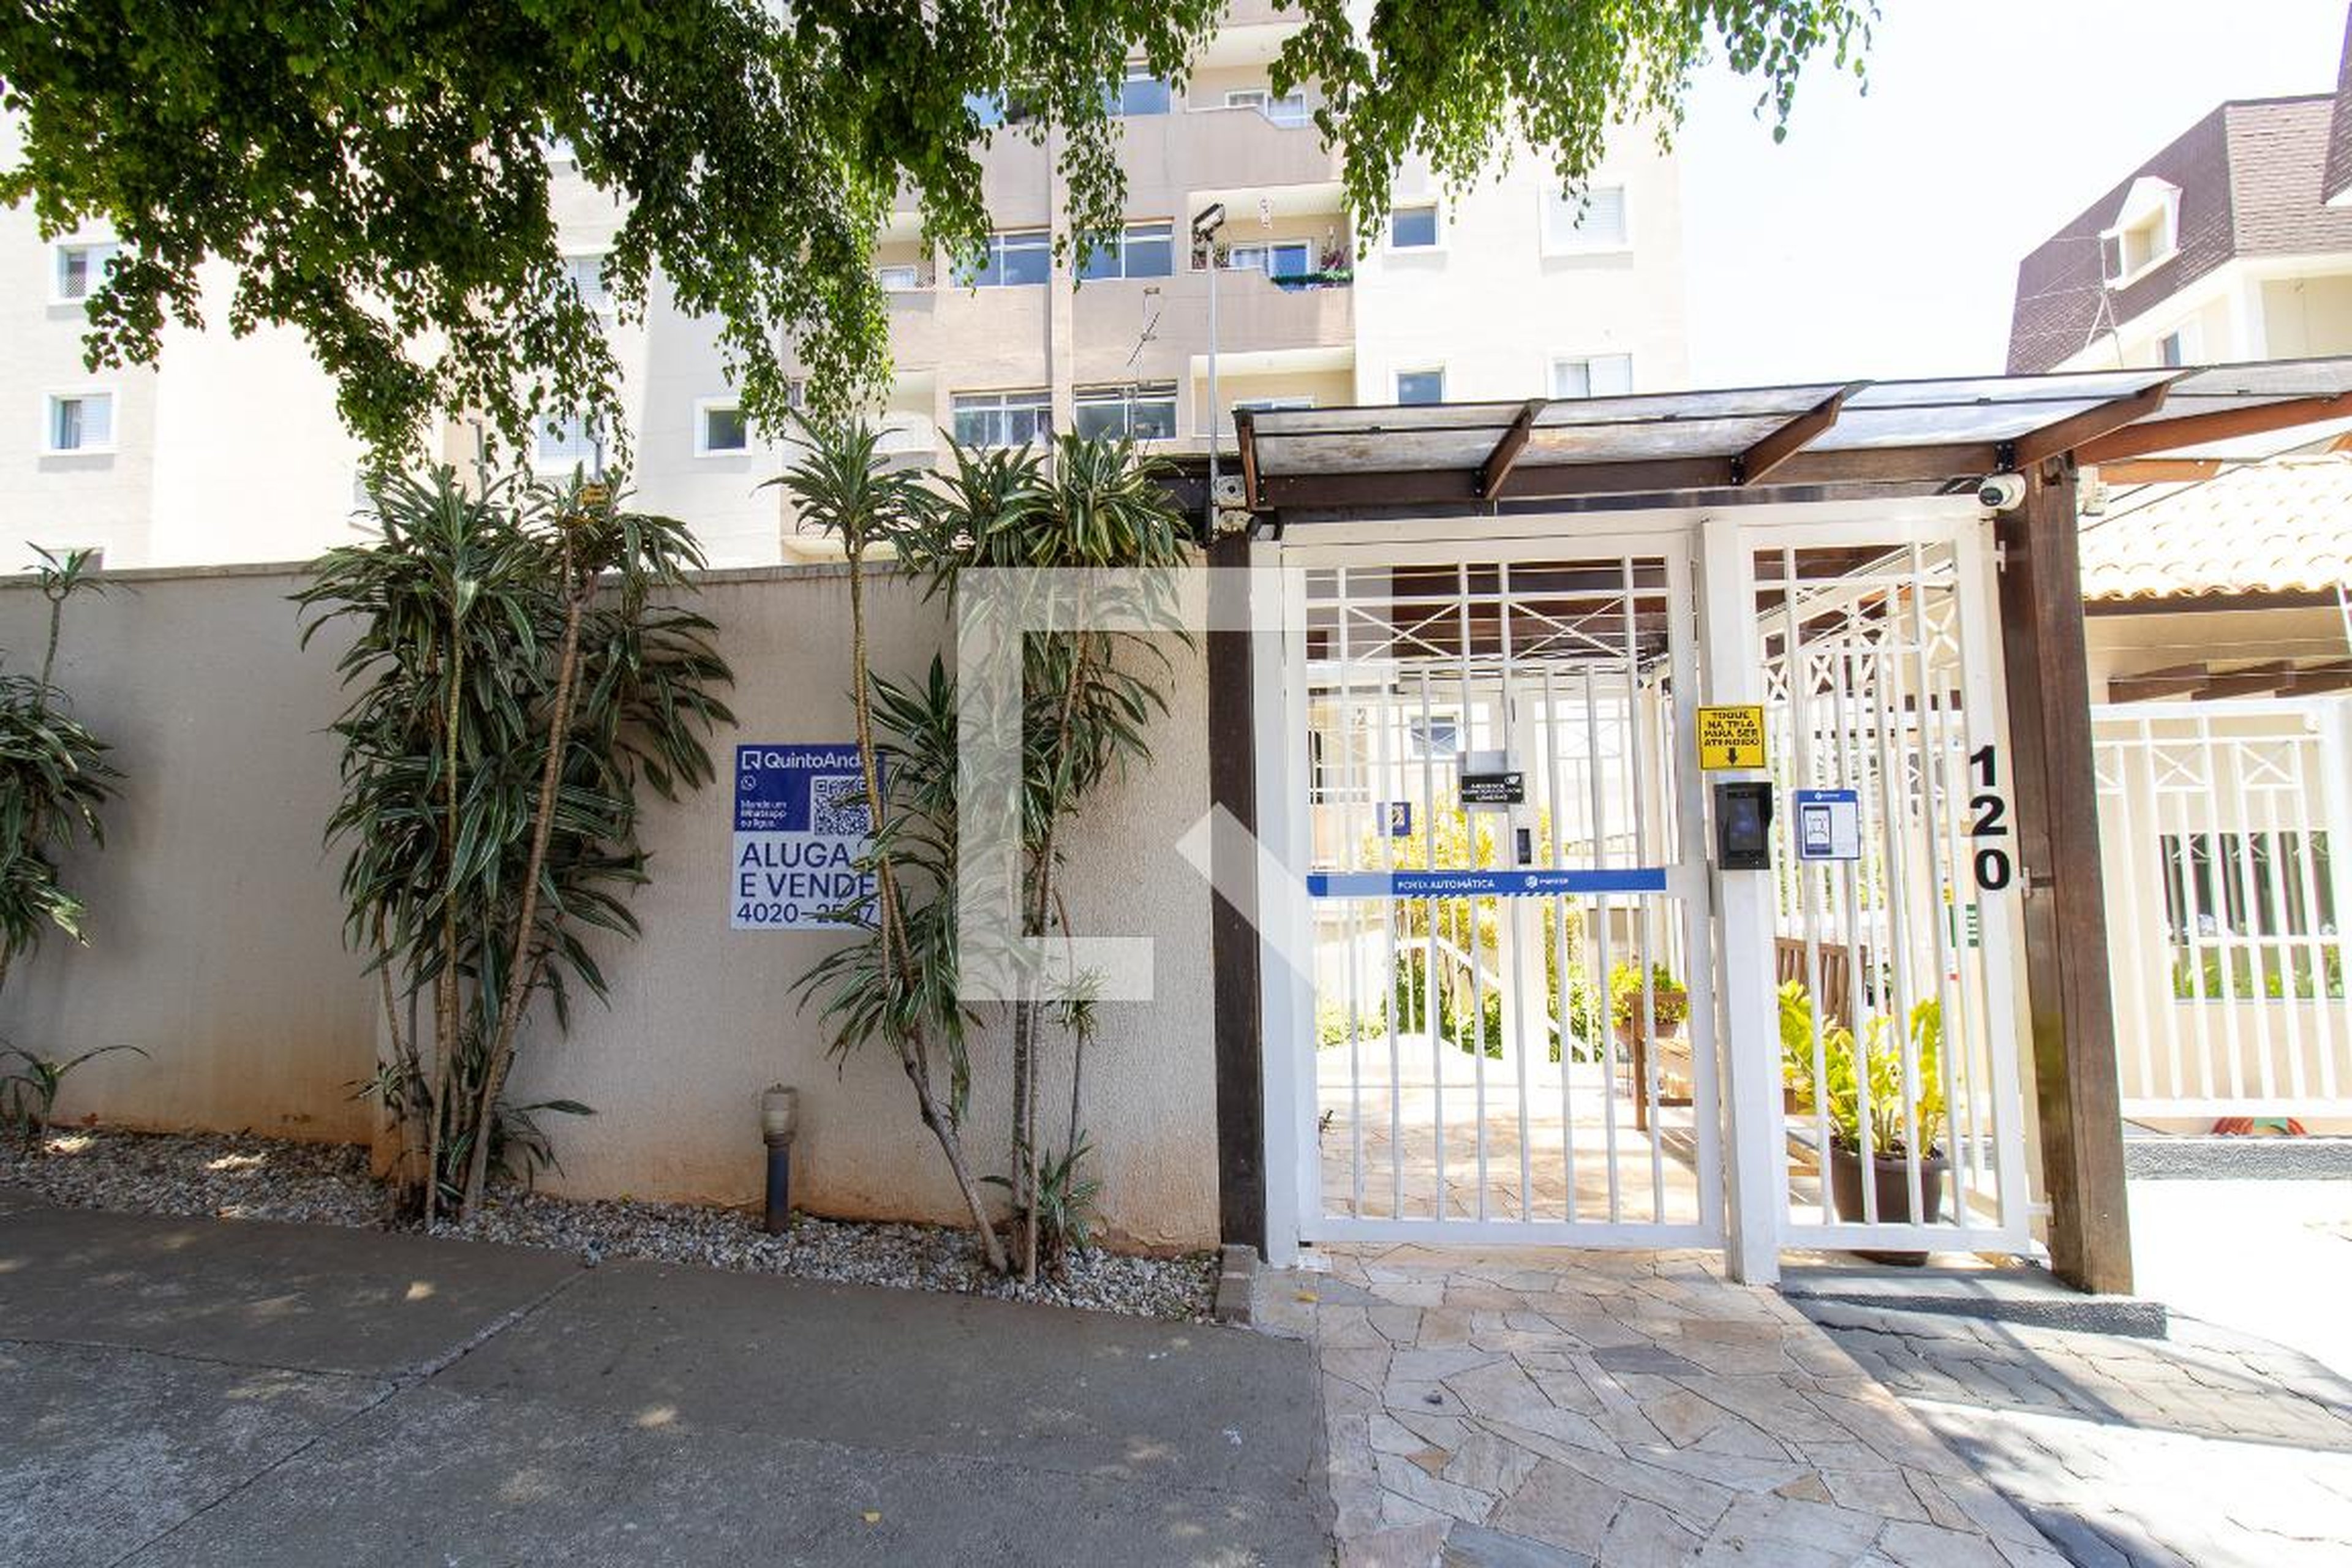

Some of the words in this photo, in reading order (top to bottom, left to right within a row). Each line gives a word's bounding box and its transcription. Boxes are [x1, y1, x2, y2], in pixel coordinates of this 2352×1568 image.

[1969, 745, 2010, 891] 120
[739, 842, 850, 868] ALUGA
[741, 873, 756, 897] E
[766, 872, 876, 899] VENDE
